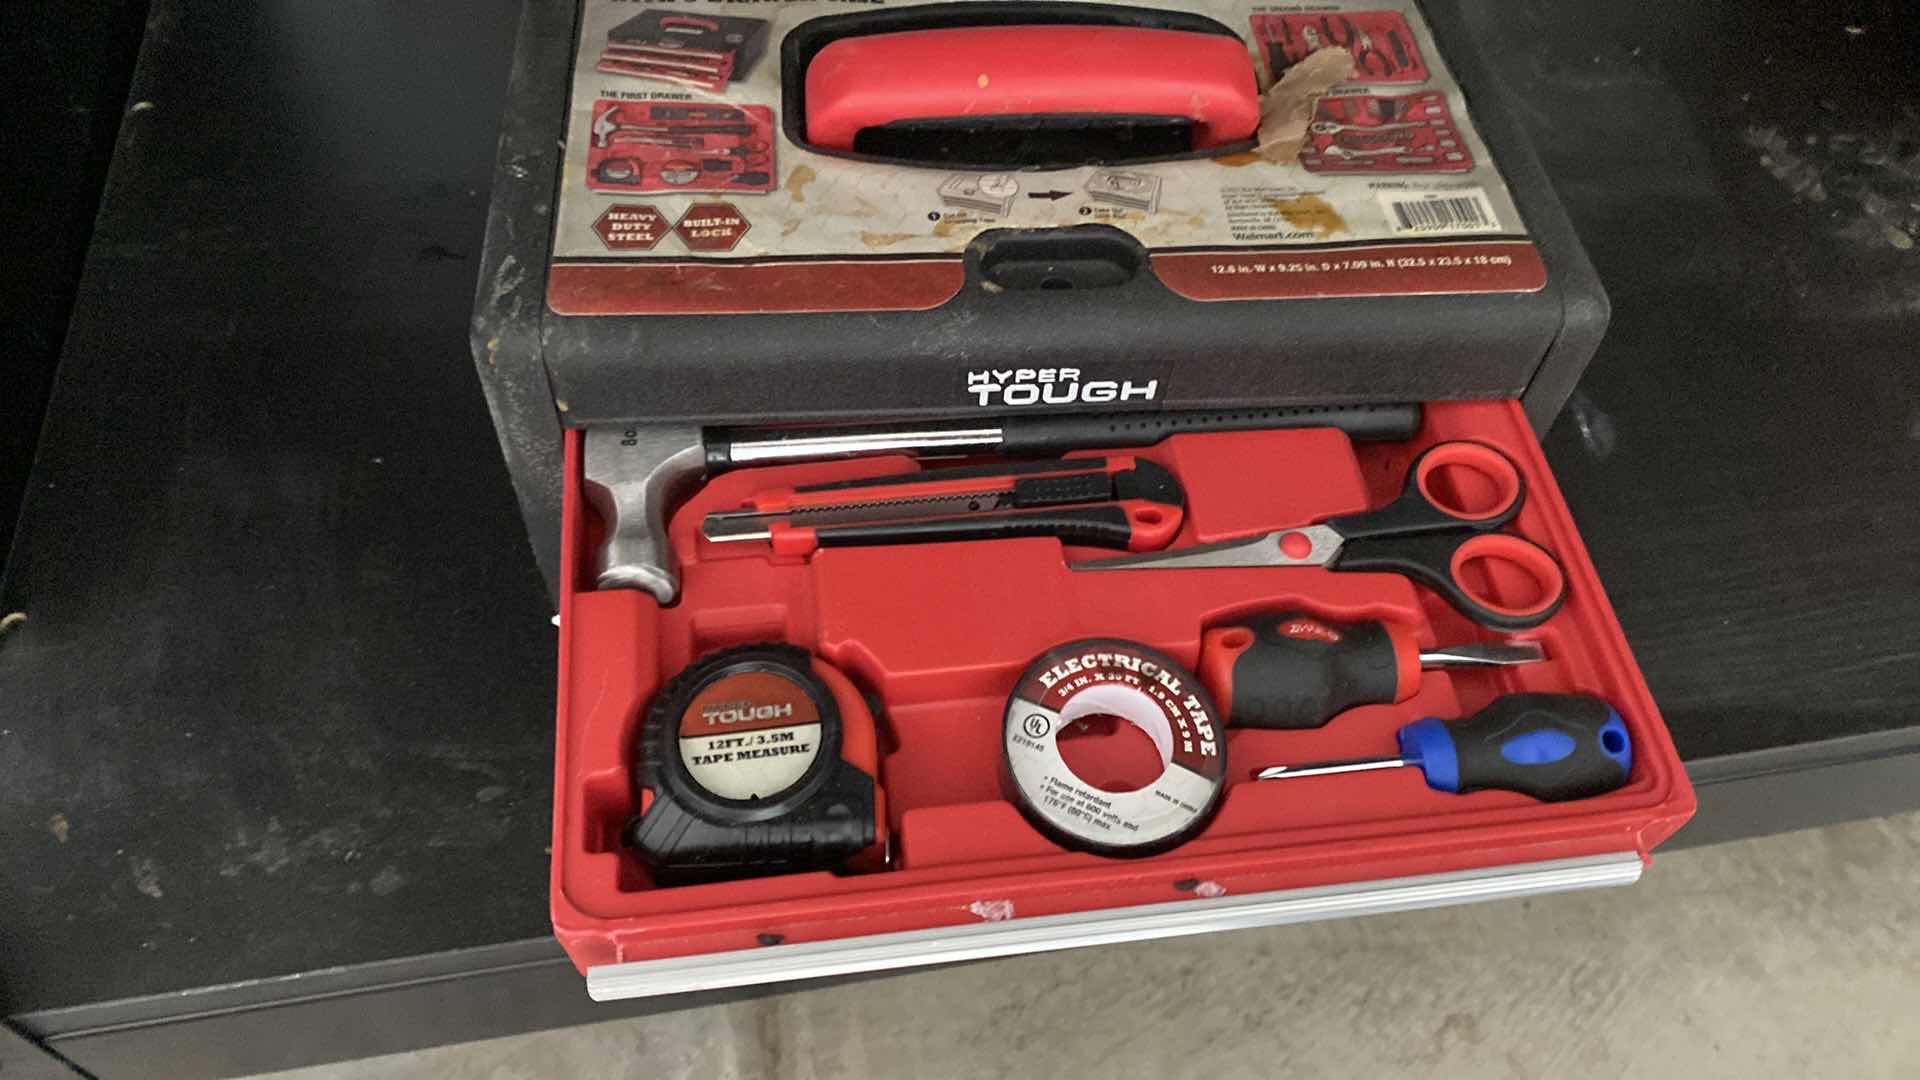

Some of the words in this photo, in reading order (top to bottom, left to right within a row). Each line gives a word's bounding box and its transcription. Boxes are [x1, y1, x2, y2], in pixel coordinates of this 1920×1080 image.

[621, 91, 647, 99] FIRST
[650, 92, 692, 100] DRAWER
[608, 212, 656, 221] HEAVY
[683, 217, 740, 228] BUILT-IN
[611, 222, 651, 231] DUTY
[690, 228, 733, 238] LOCK
[608, 232, 654, 241] STEEL
[1232, 231, 1314, 240] Walmart.com
[1254, 264, 1266, 273] W
[968, 368, 1080, 385] HYPER
[968, 380, 1158, 406] TOUGH
[1038, 653, 1182, 696] ELECTRICAL
[1183, 694, 1217, 756] TAPE
[1058, 682, 1075, 697] 3/4
[1074, 675, 1092, 687] IN.
[1094, 673, 1105, 681] X
[1177, 718, 1188, 729] X
[703, 703, 792, 725] TOUGH
[757, 732, 794, 745] 3.5M
[692, 753, 733, 766] TAPE
[737, 743, 810, 761] MEASURE
[1050, 777, 1074, 792] Flame
[1075, 789, 1112, 808] retardant
[1046, 785, 1059, 796] For
[1060, 793, 1075, 802] use
[1076, 799, 1085, 807] at
[1085, 803, 1102, 814] 600
[1103, 812, 1121, 824] volts
[1123, 820, 1139, 831] and
